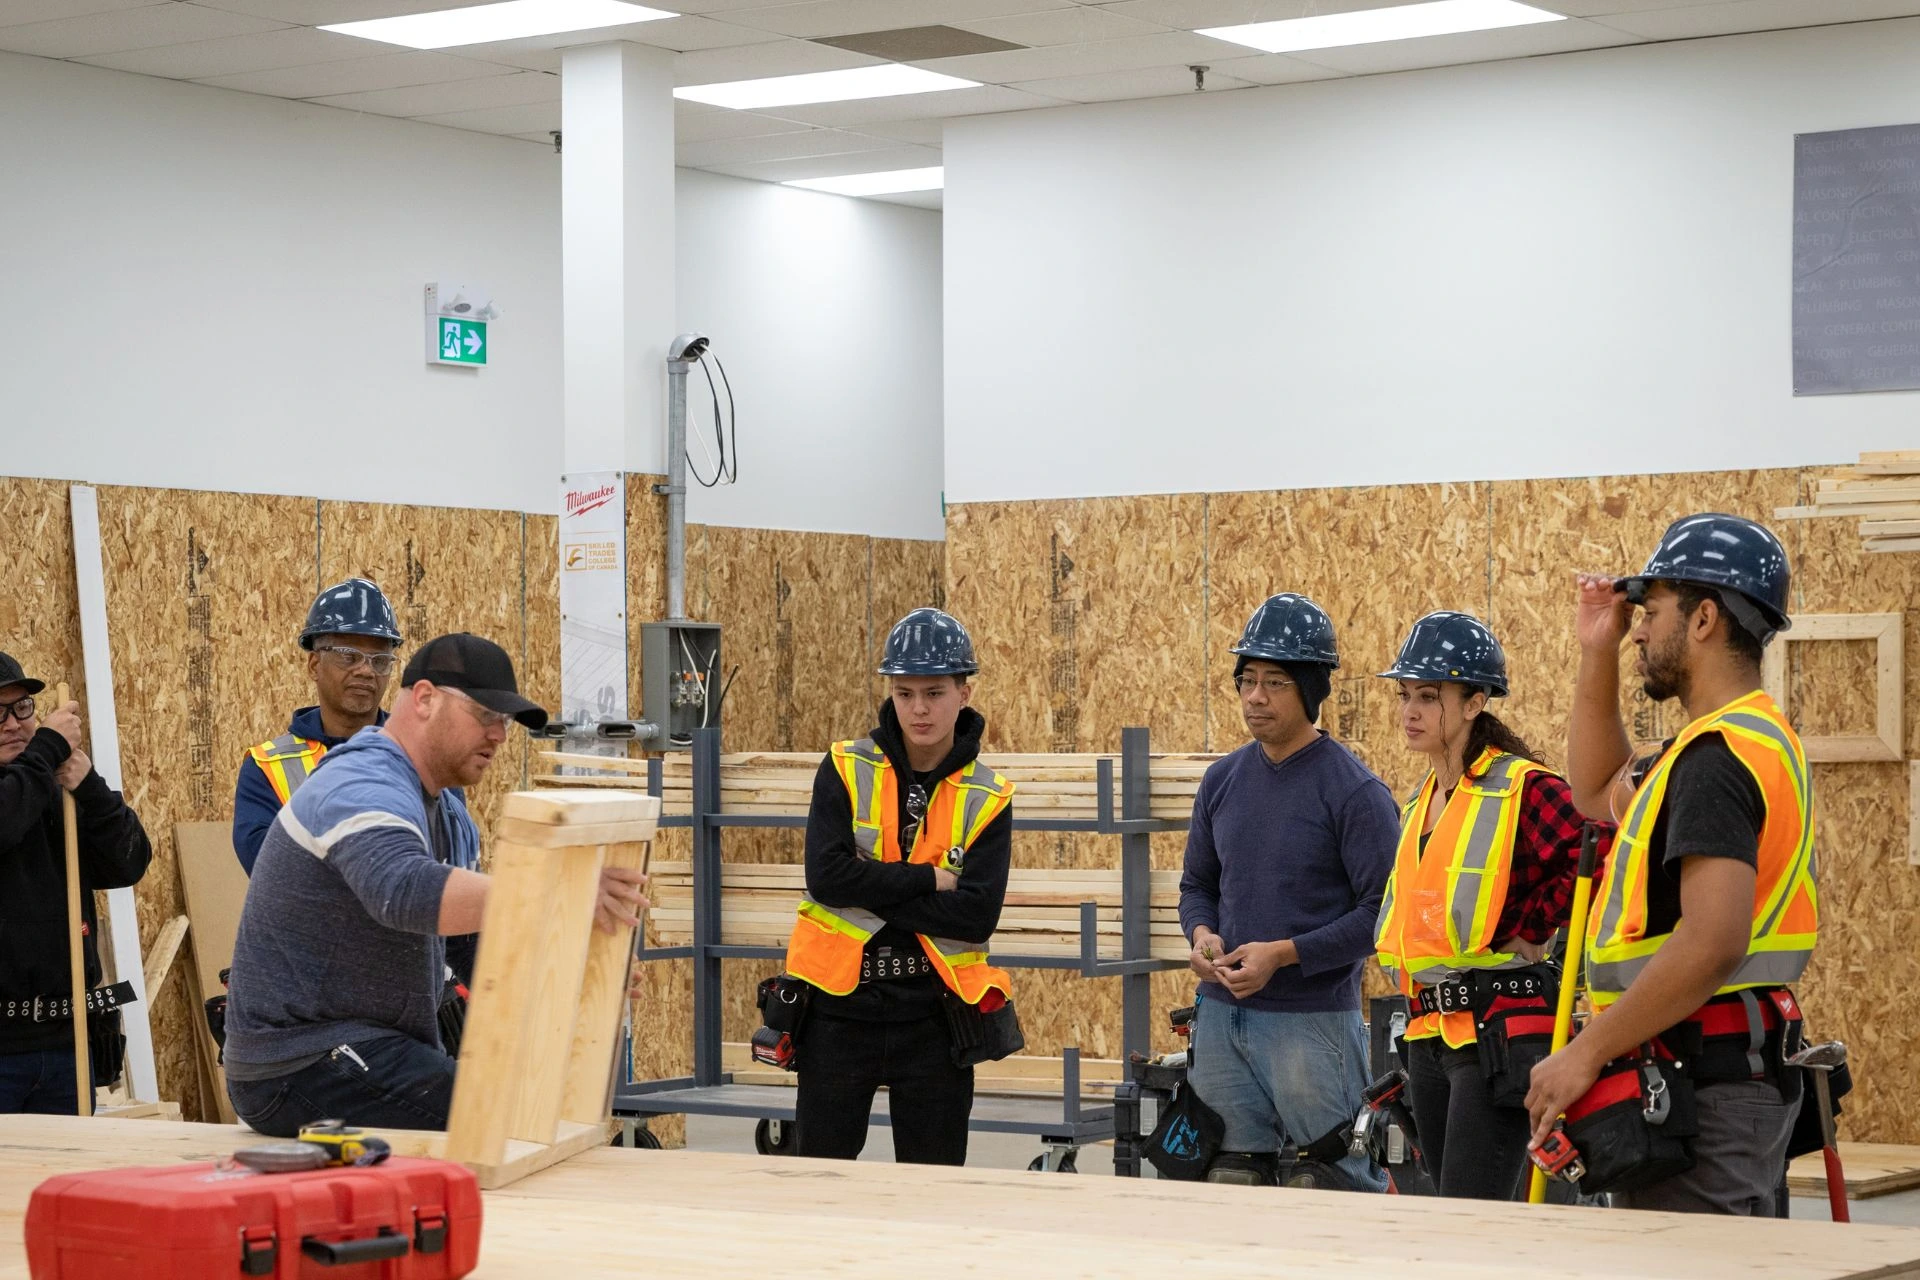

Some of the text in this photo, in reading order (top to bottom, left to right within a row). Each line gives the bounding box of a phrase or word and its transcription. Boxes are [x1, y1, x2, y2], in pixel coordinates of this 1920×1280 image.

[1849, 228, 1917, 243] ELECTRICAL
[1840, 276, 1902, 290] PLUMBING
[1824, 322, 1879, 336] GENERAL
[564, 485, 616, 512] Milwaukee
[1635, 710, 1649, 738] APA
